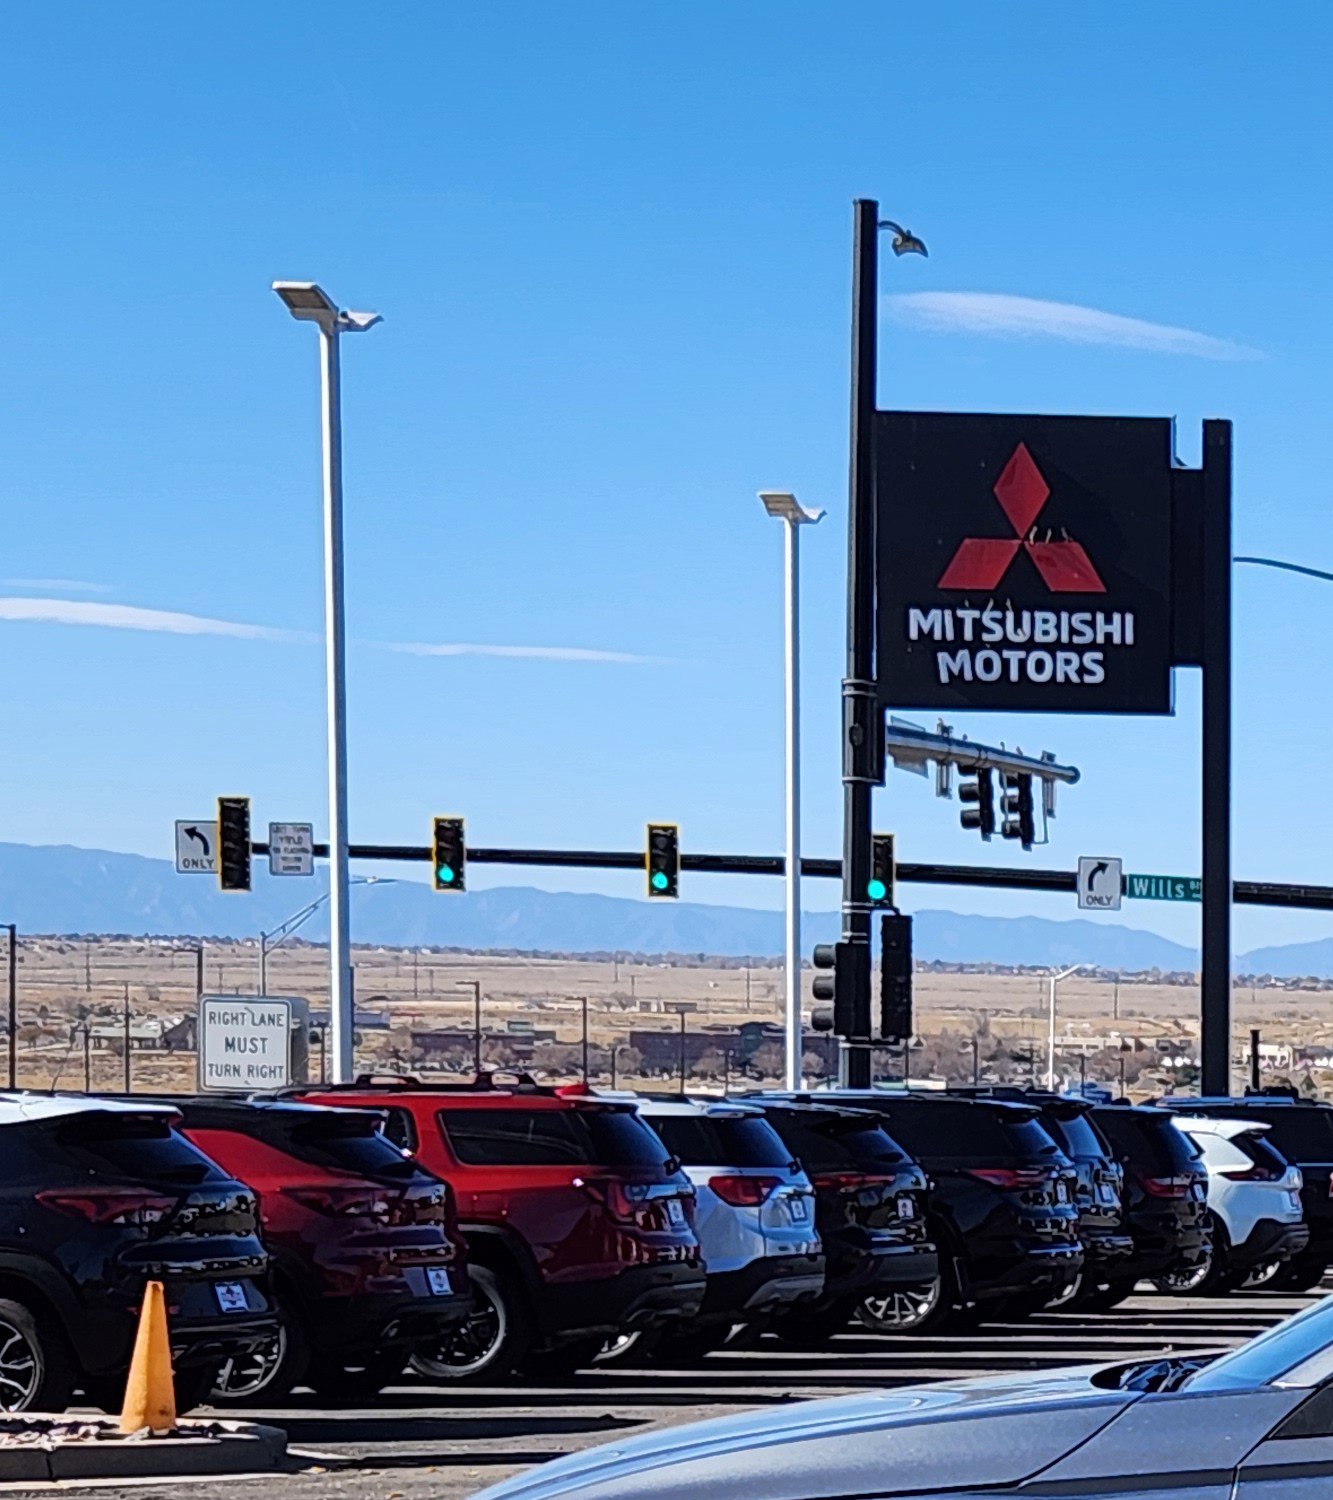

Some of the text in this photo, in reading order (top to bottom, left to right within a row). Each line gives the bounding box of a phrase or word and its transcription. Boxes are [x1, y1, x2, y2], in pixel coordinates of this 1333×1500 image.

[908, 607, 1135, 646] MITSUBISHI
[936, 648, 1105, 684] MOTORS
[182, 858, 214, 869] ONLY
[1133, 878, 1185, 899] Wills
[1085, 894, 1113, 906] ONLY
[208, 1011, 285, 1027] RIGHT LANE
[224, 1036, 268, 1054] MUST
[208, 1063, 285, 1079] TURN RIGHT
